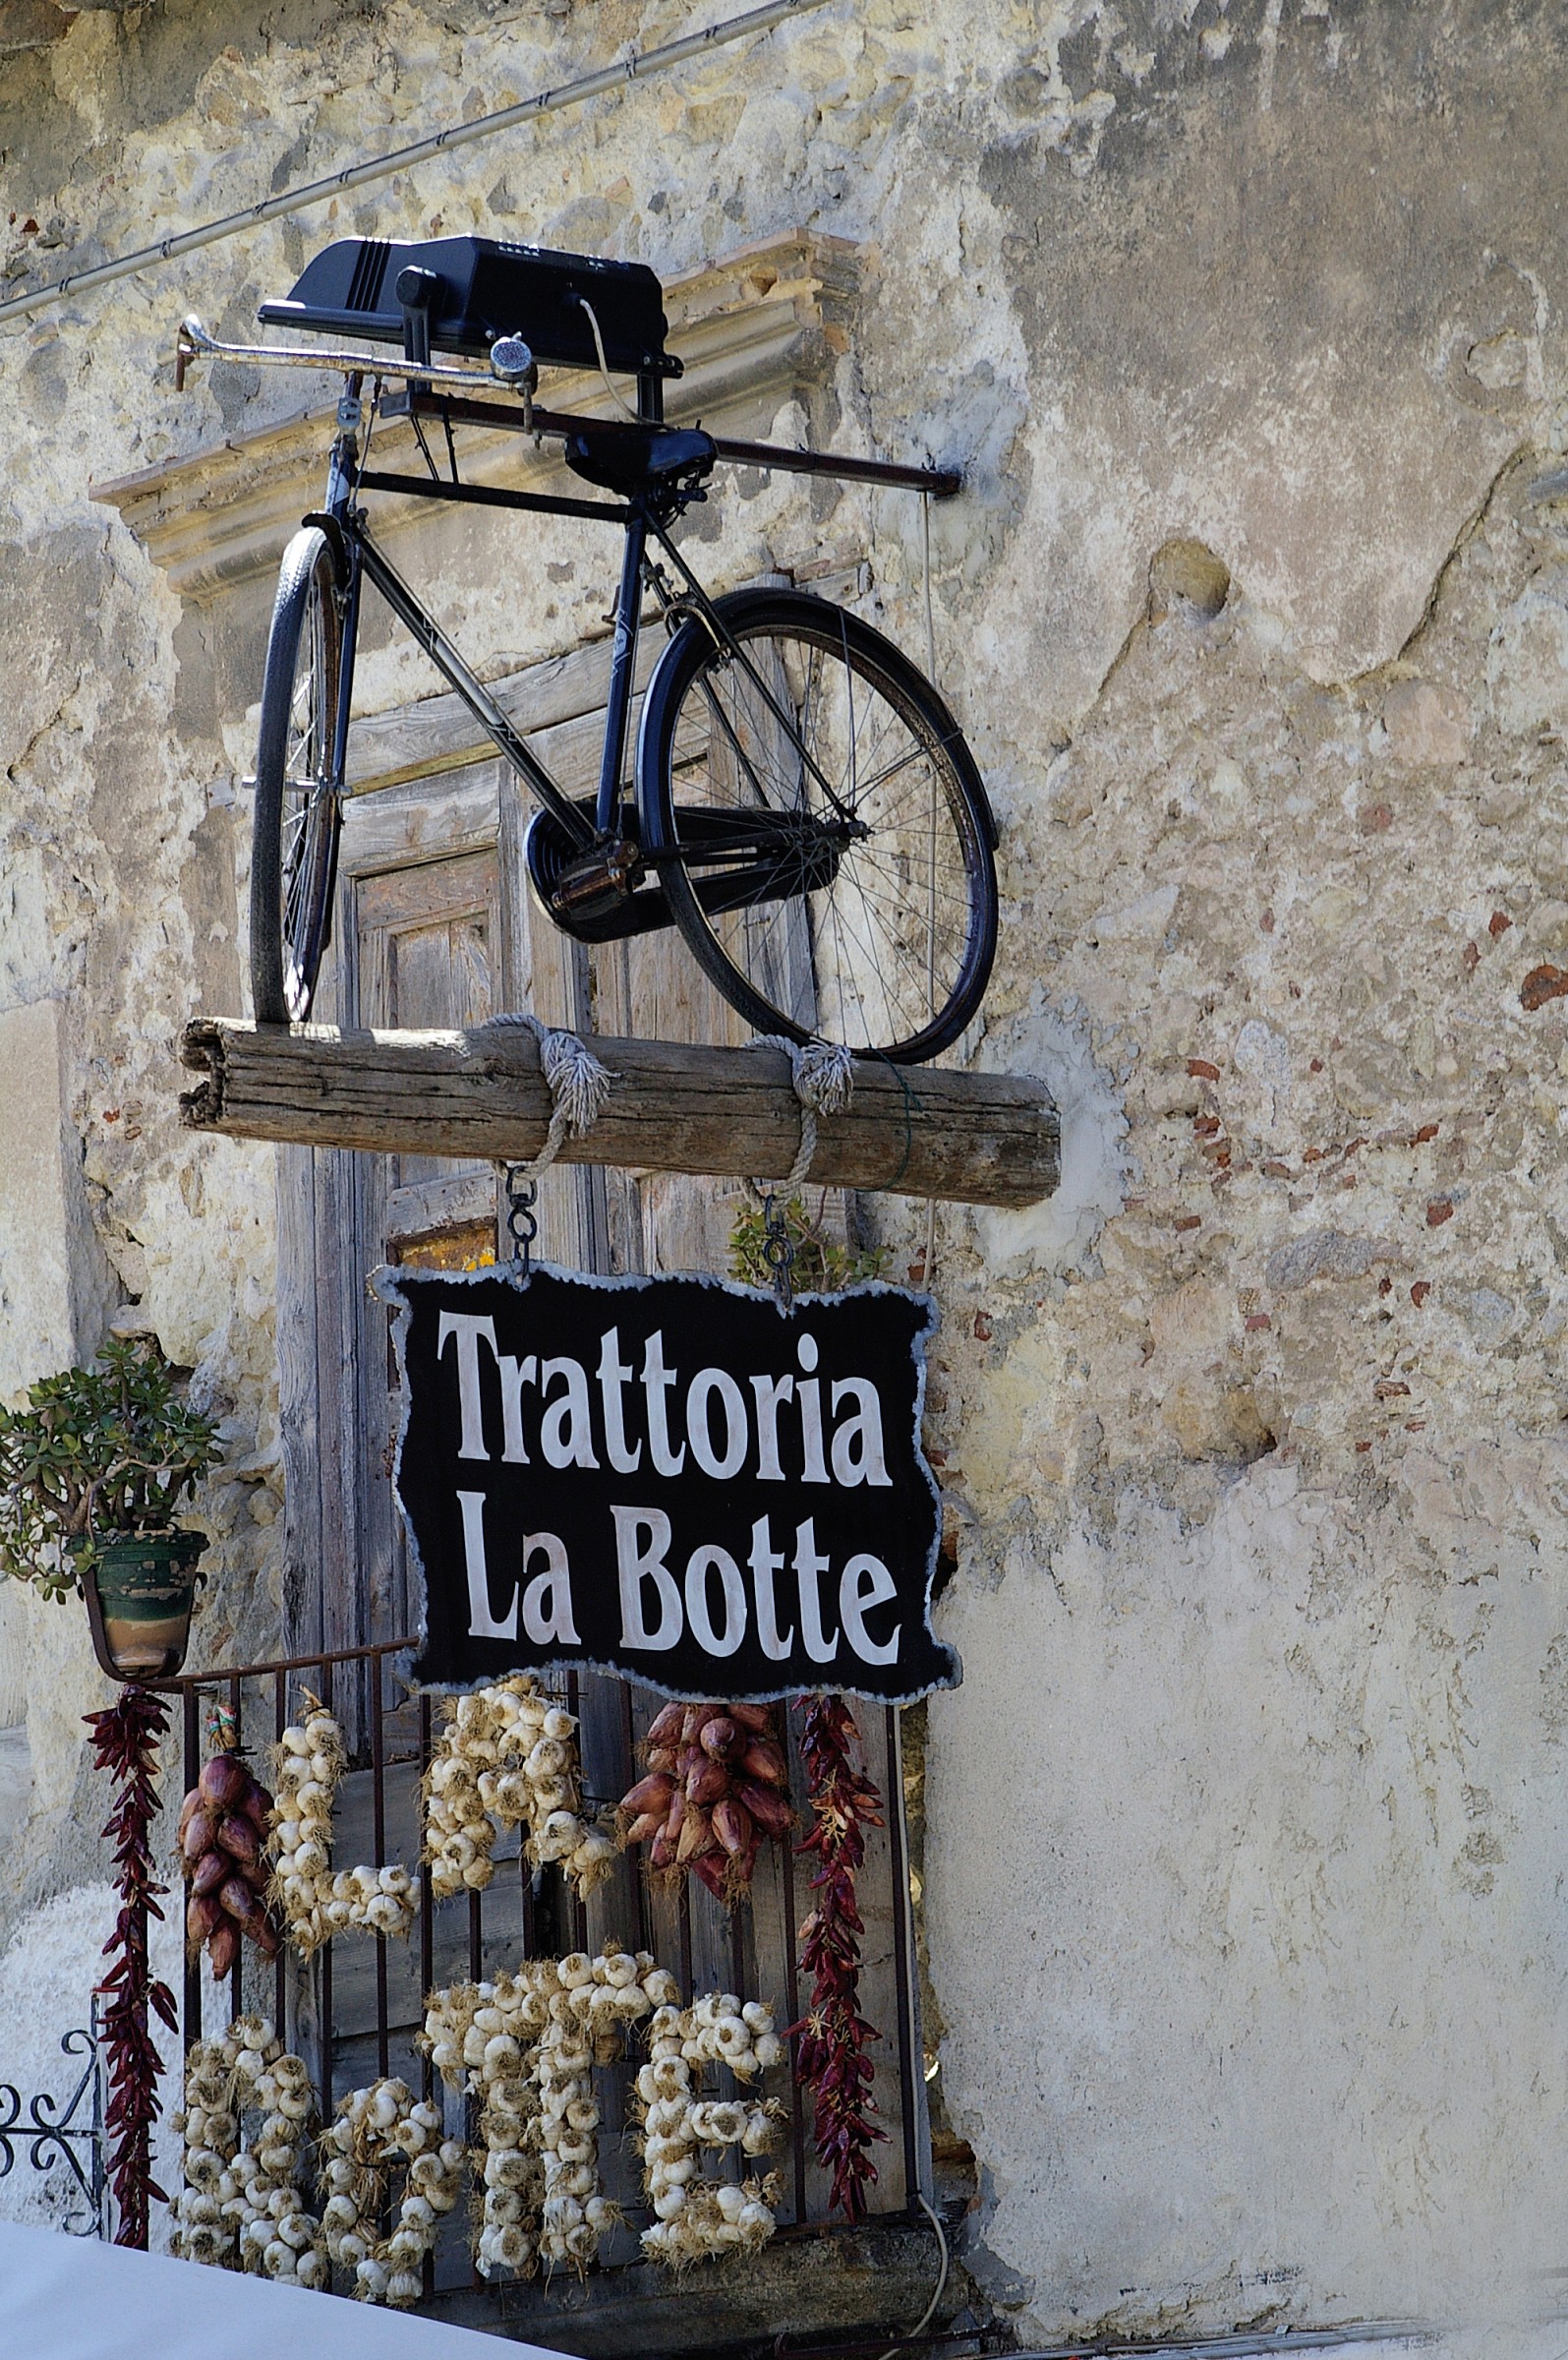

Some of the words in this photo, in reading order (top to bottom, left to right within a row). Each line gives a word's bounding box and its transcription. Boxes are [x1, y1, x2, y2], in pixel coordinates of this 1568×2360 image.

[437, 1309, 894, 1488] Trattoria
[455, 1490, 582, 1645] La
[610, 1504, 900, 1666] Botte
